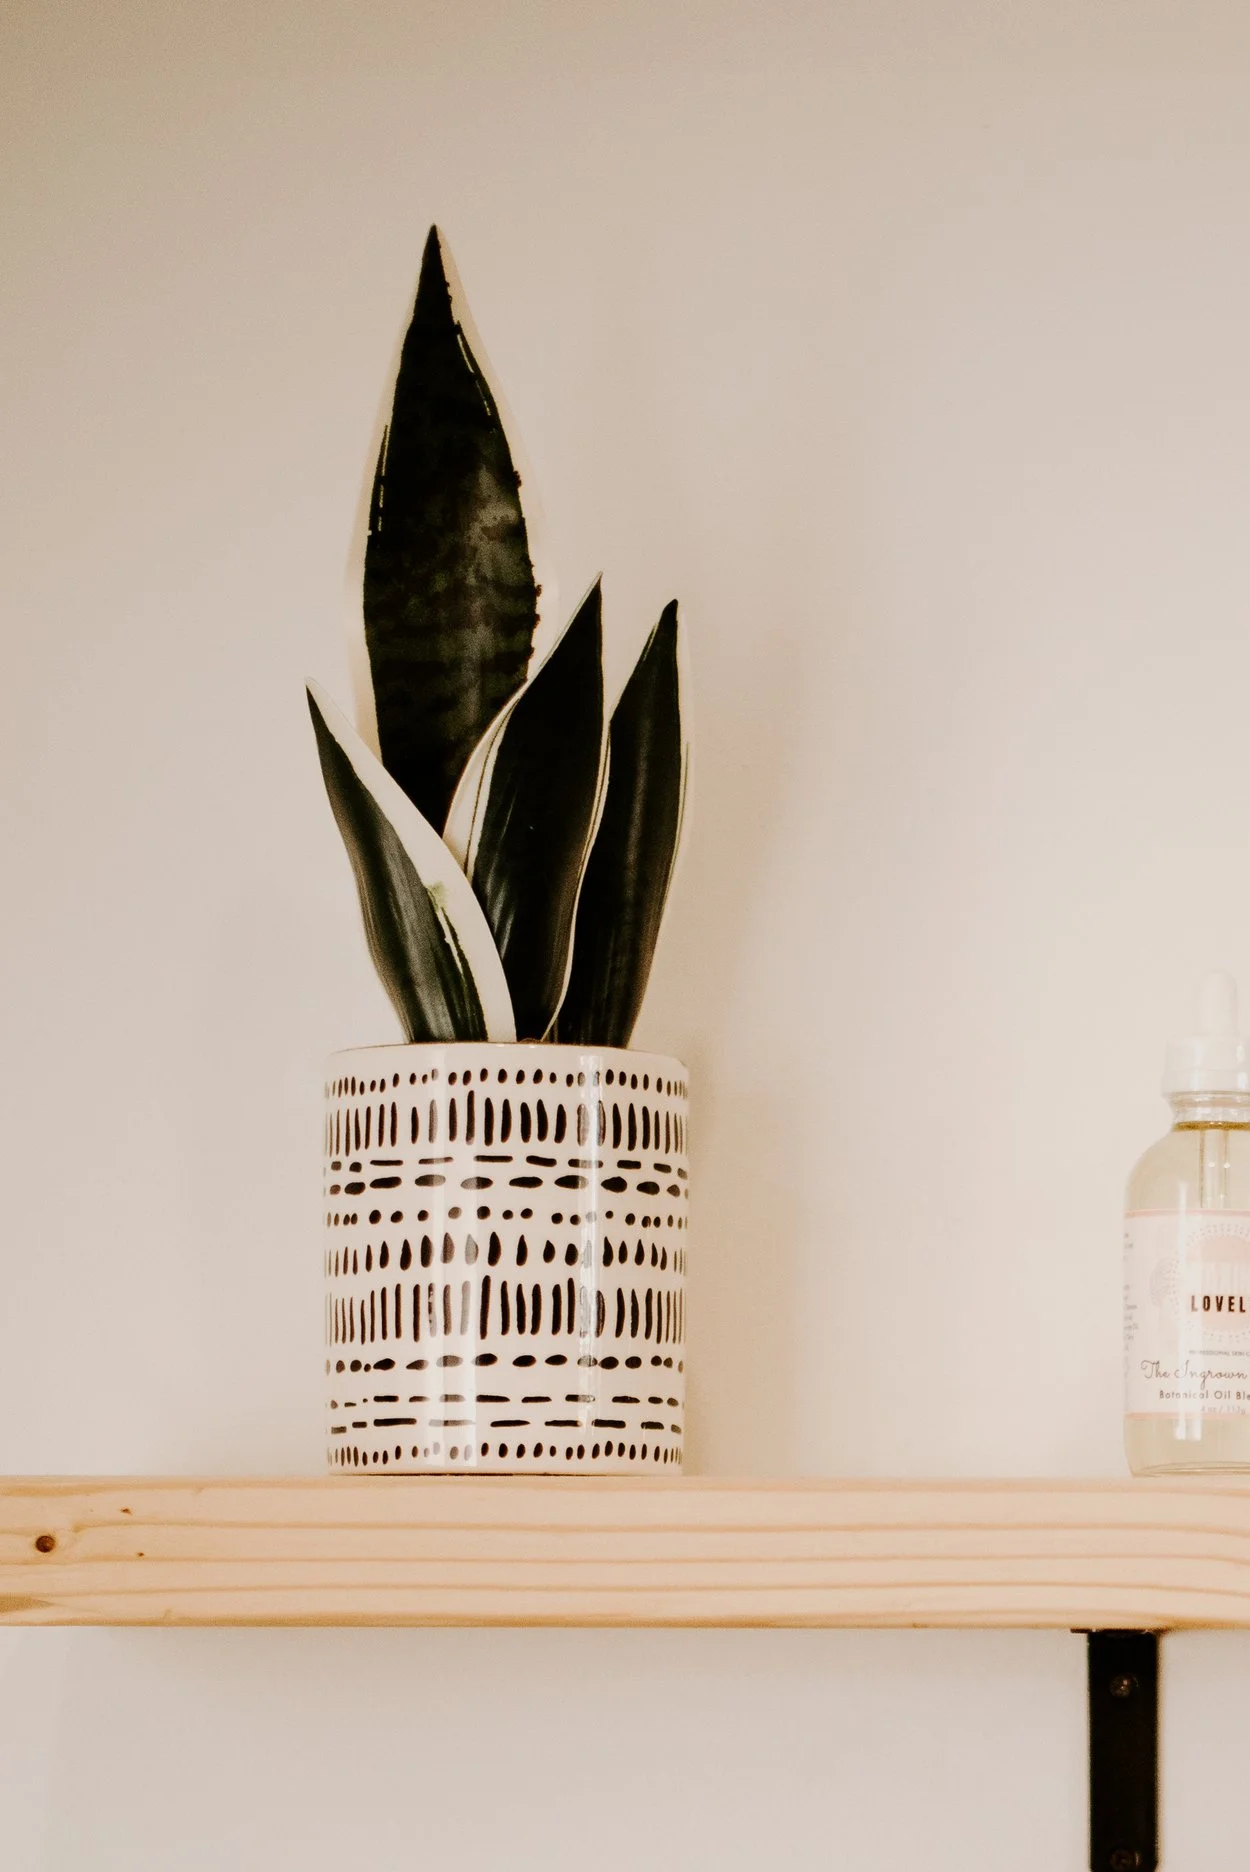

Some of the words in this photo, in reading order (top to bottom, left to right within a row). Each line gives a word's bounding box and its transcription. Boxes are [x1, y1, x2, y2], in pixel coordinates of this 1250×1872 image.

[1140, 1359, 1170, 1380] The
[1174, 1359, 1248, 1390] Ingrown
[1159, 1390, 1209, 1400] Botanical
[1213, 1390, 1231, 1400] Oil
